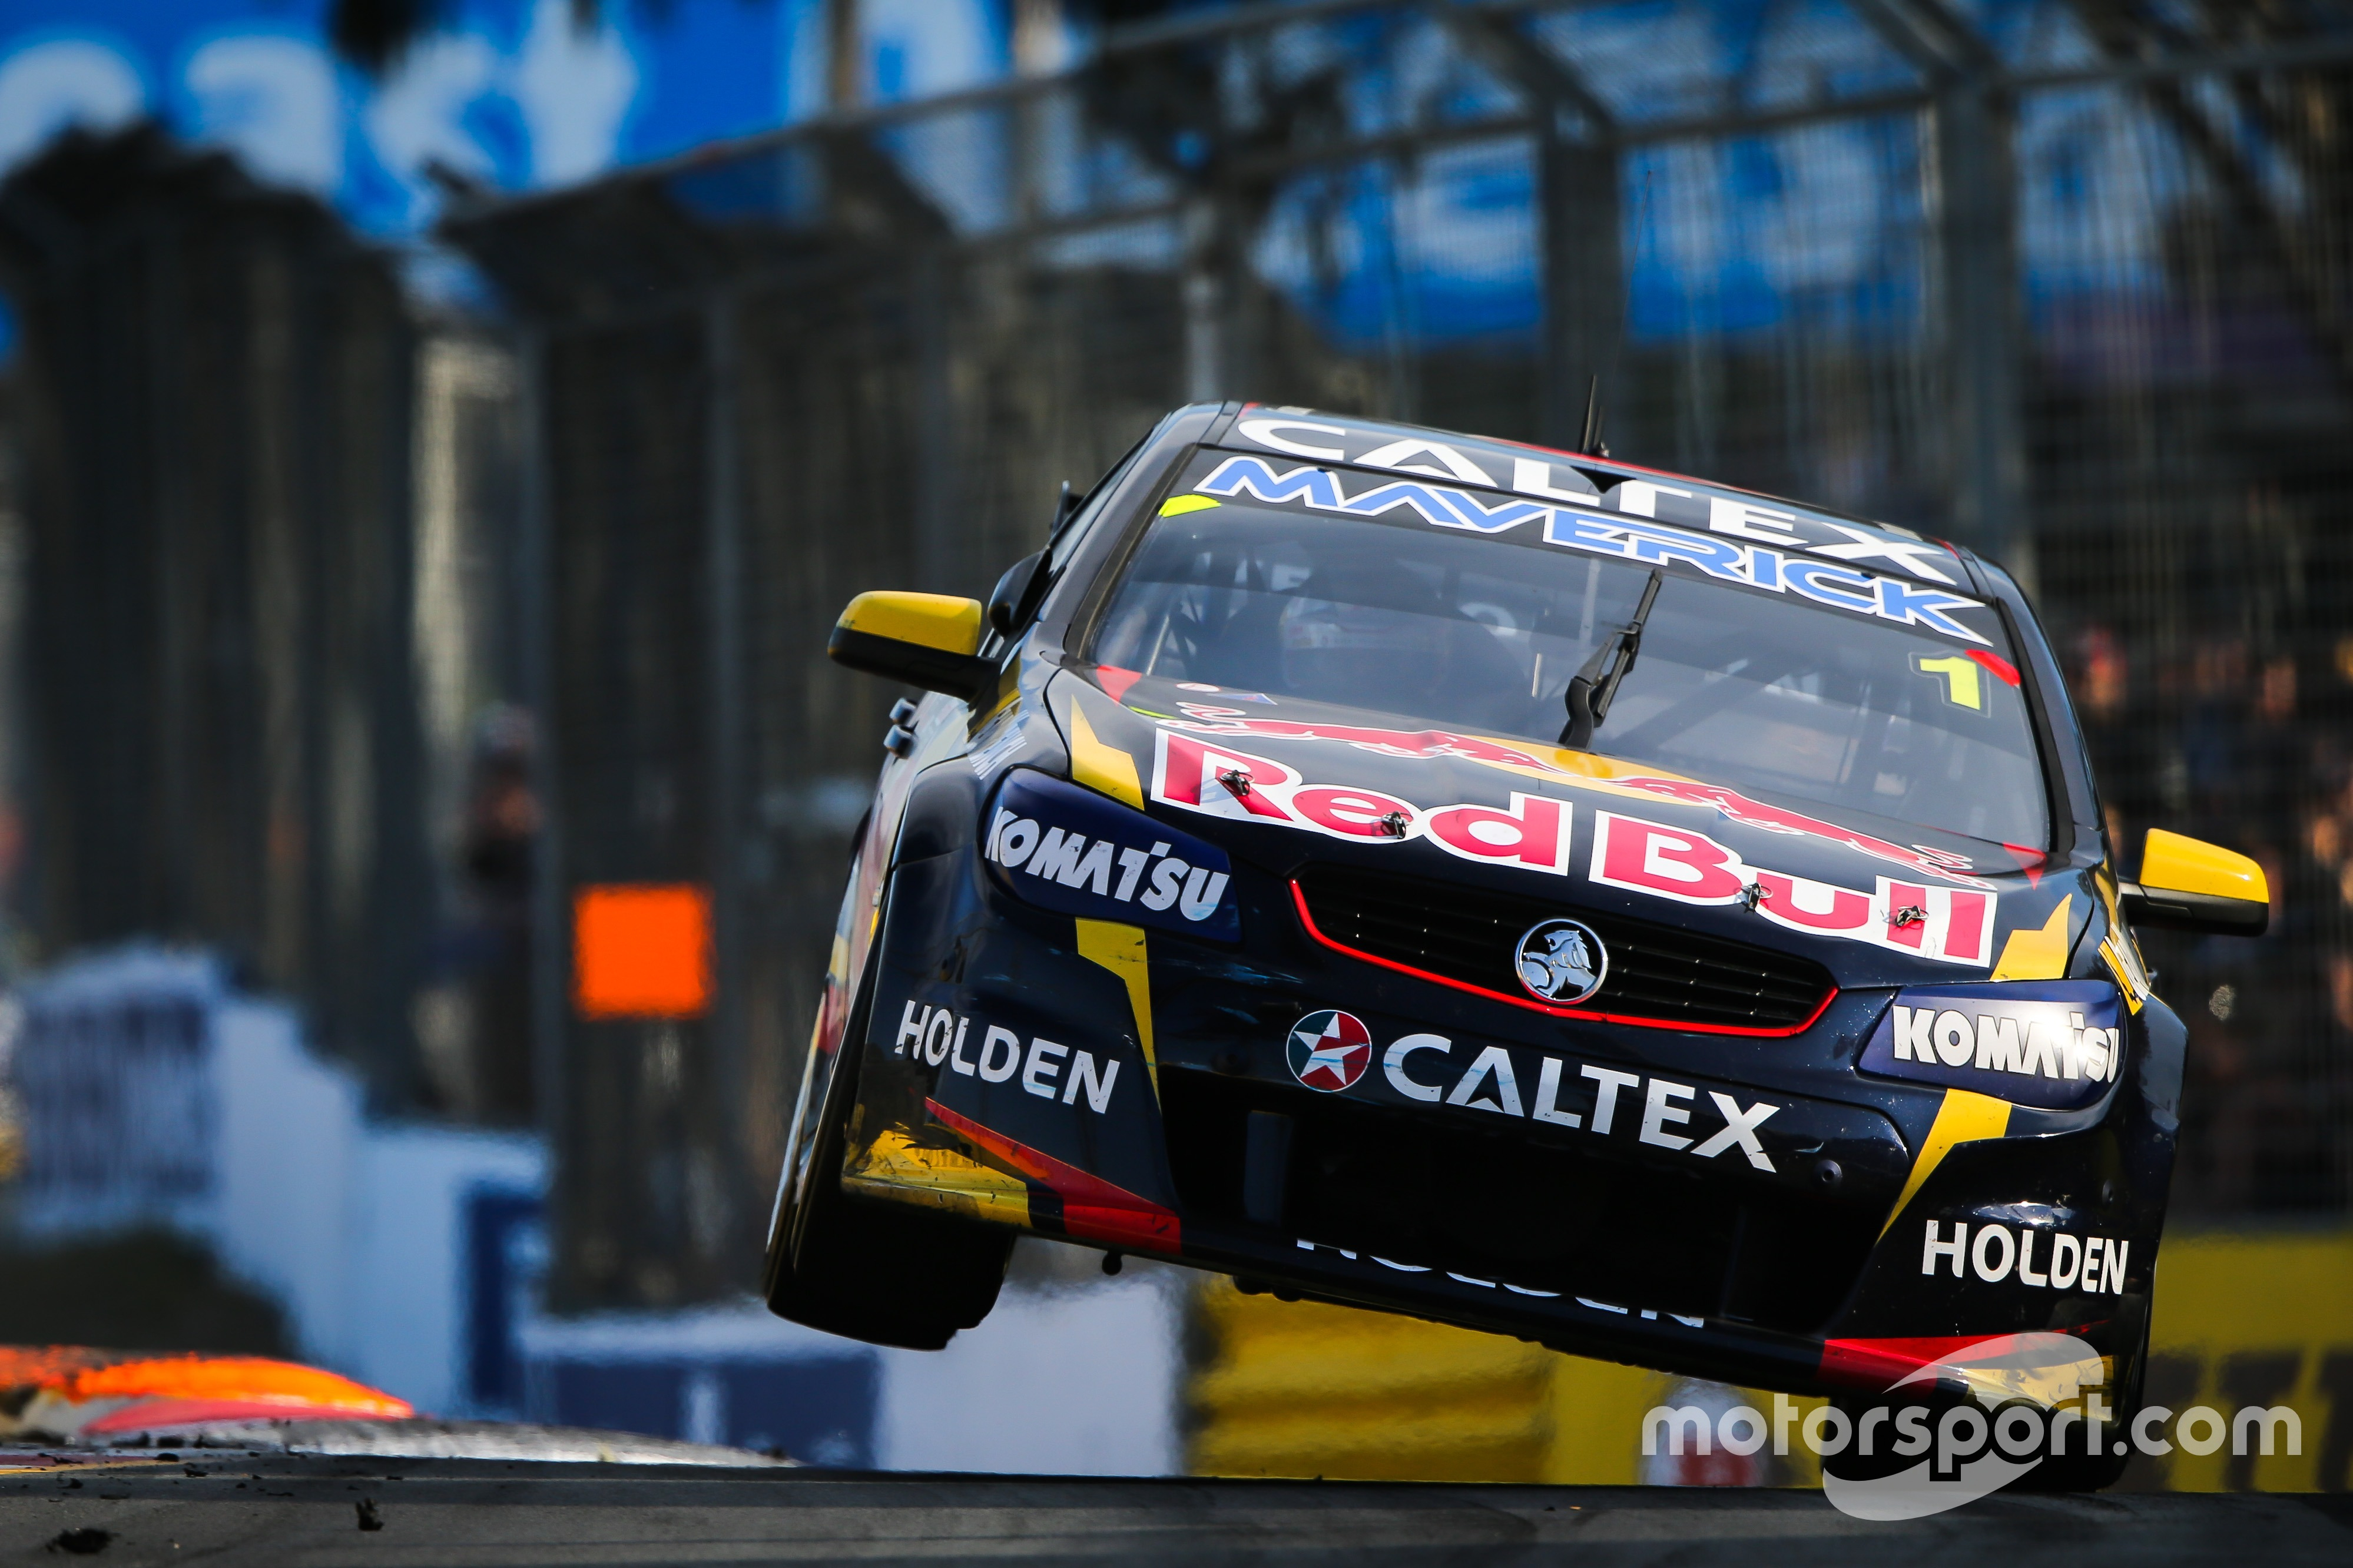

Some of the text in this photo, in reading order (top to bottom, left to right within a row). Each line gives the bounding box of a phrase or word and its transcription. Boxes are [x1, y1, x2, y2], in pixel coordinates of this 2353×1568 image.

[1193, 456, 1993, 647] MAVERICK
[1238, 419, 1957, 586] CALTEX
[1920, 656, 1981, 711] 1
[985, 807, 1229, 921] KOMATSU
[1151, 728, 1572, 875] Red
[1588, 810, 1997, 968] Bull
[894, 1000, 1120, 1114] HOLDEN
[1893, 1005, 2119, 1083] KOMATSU
[1383, 1033, 1780, 1173] CALTEX
[1922, 1219, 2129, 1294] HOLDEN
